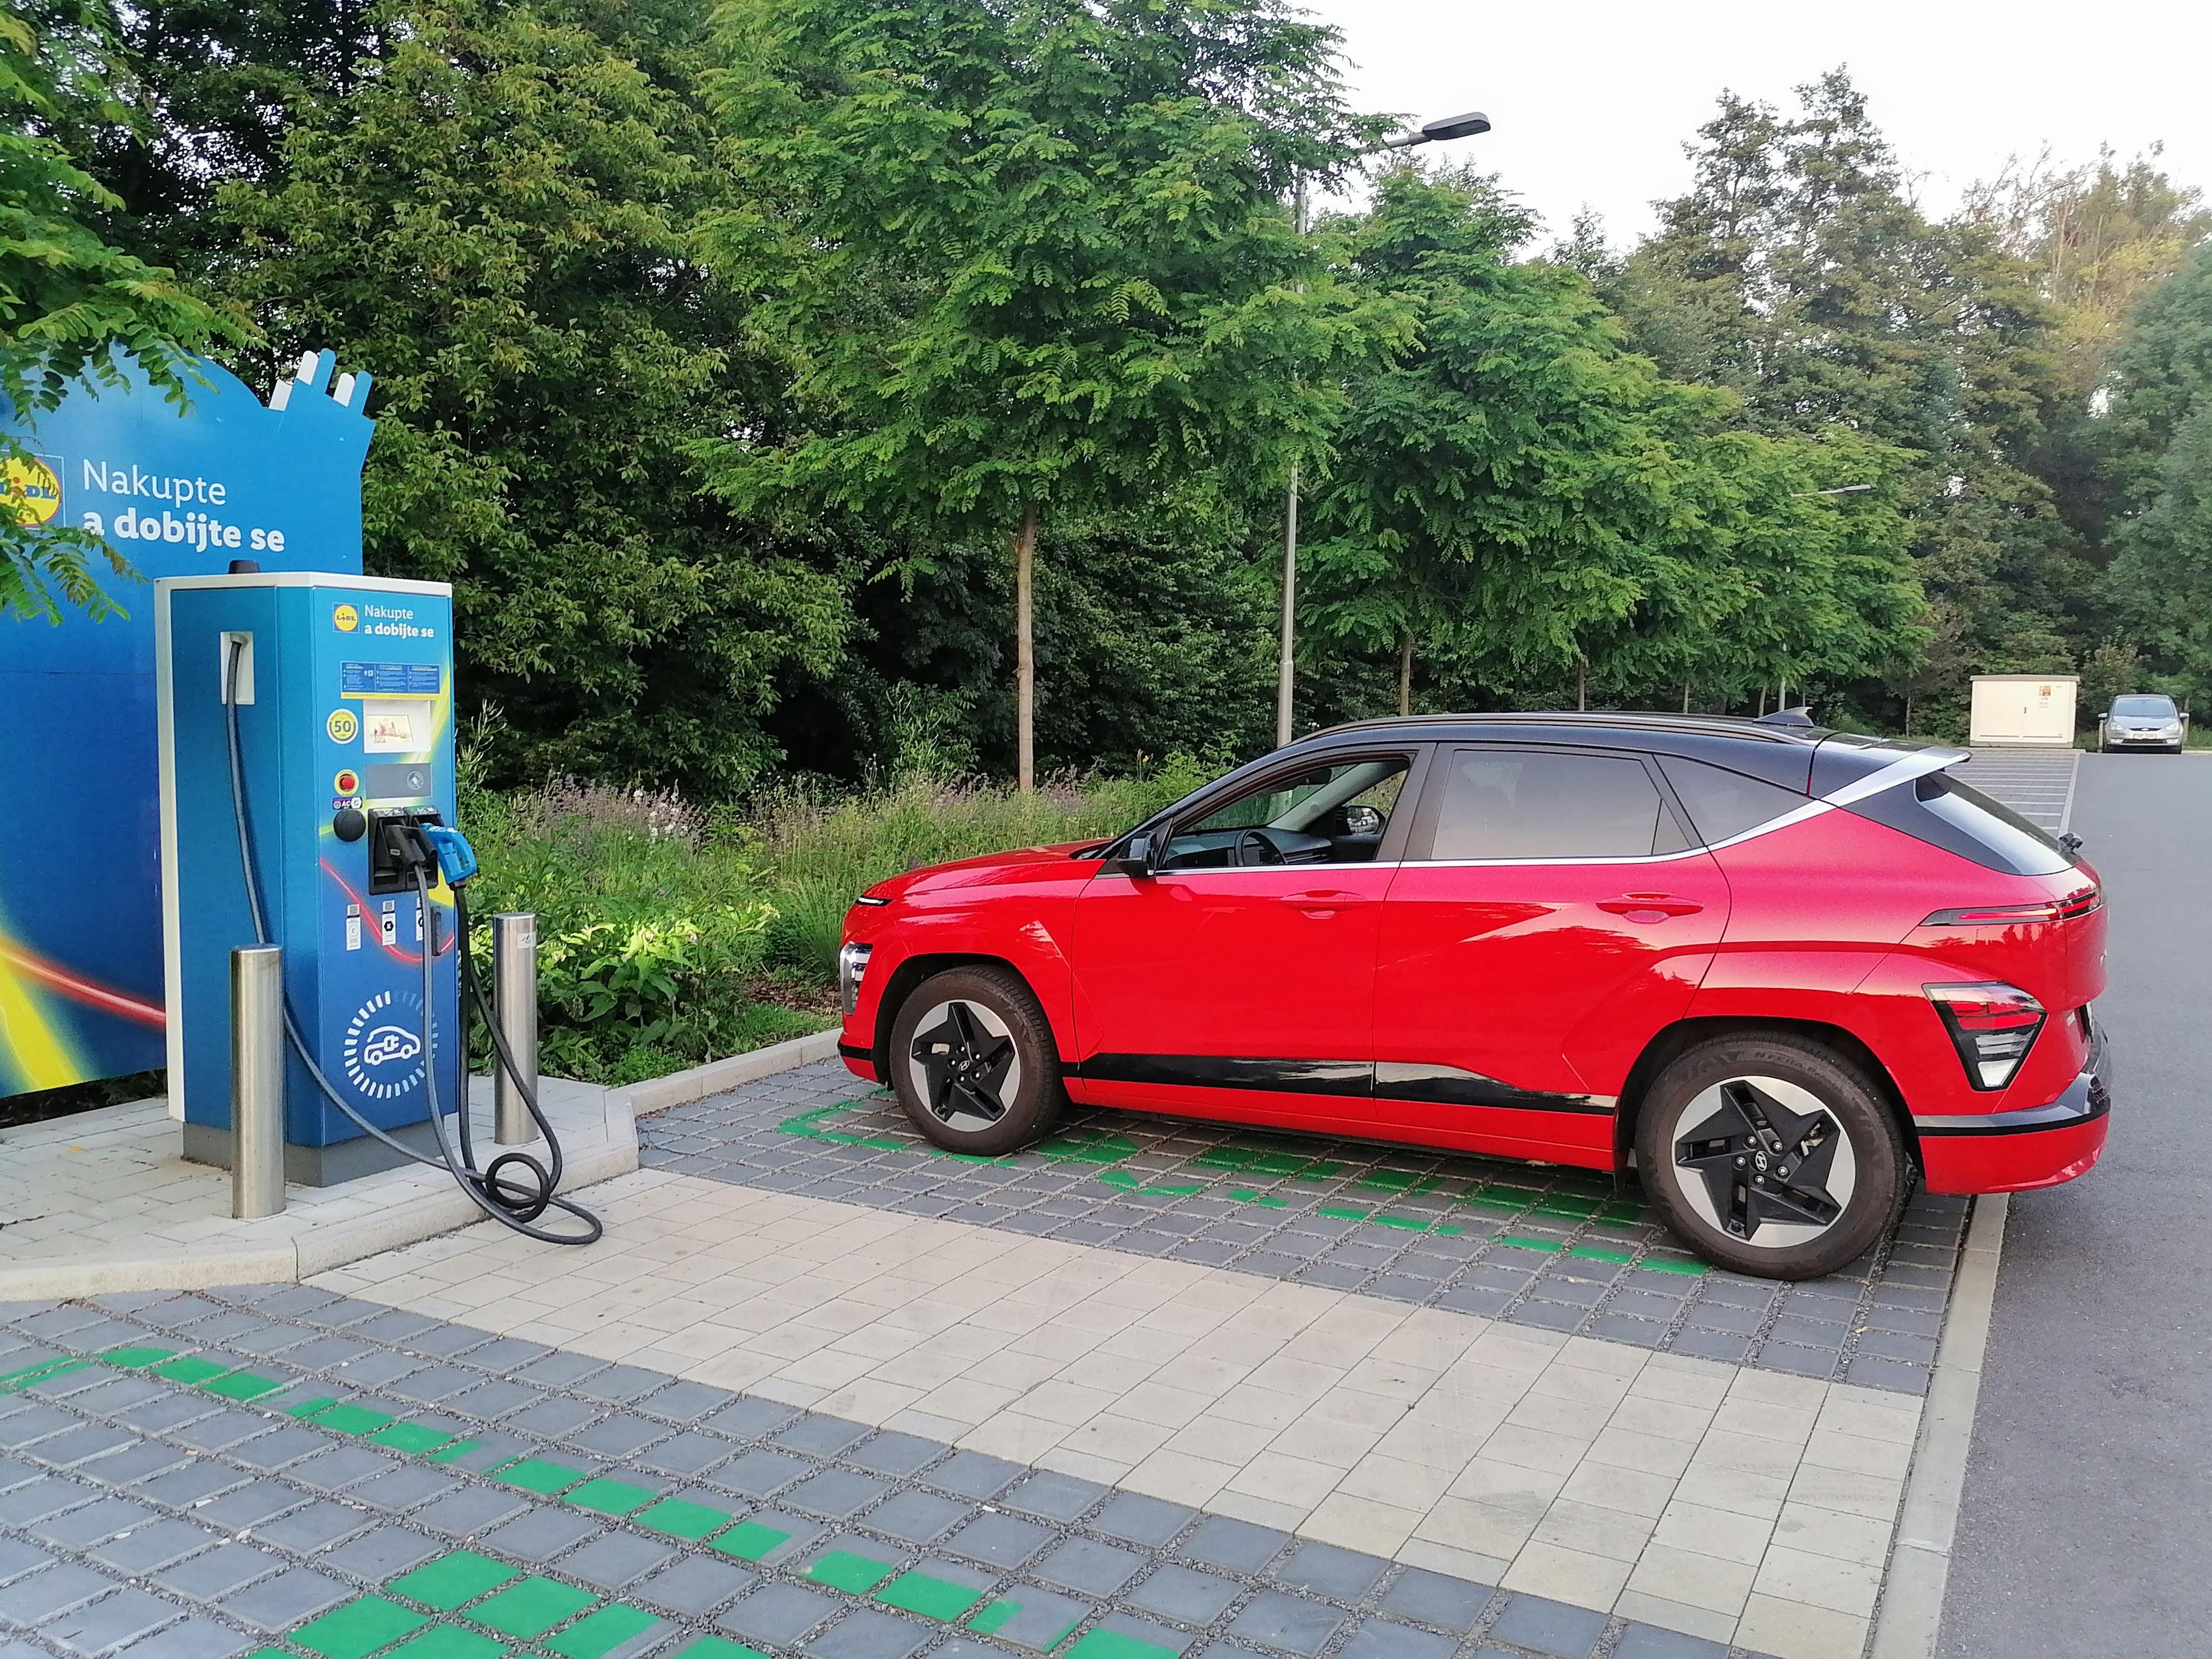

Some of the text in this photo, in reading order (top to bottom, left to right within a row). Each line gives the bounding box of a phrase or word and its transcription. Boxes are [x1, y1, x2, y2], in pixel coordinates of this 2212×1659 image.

[83, 458, 226, 508] Nakupte
[82, 507, 285, 553] a dobijte se
[364, 604, 414, 621] Nakupte
[364, 622, 434, 639] a dobijte se
[335, 720, 351, 733] 50
